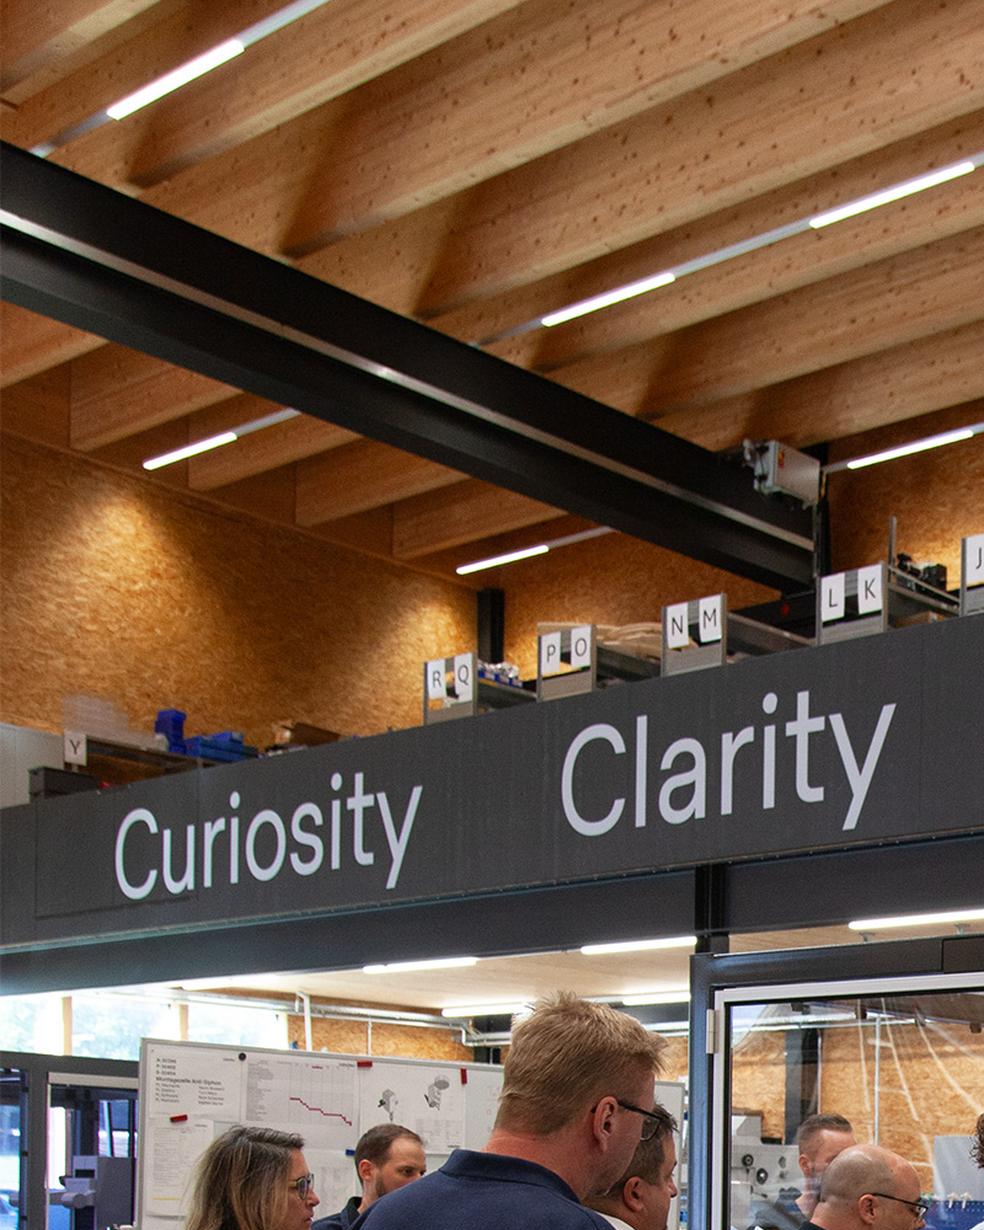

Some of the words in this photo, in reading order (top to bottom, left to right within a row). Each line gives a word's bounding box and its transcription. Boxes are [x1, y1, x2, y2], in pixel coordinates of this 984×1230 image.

[975, 547, 984, 570] J
[828, 588, 839, 609] L
[864, 578, 876, 601] K
[671, 615, 684, 636] N
[702, 607, 717, 629] M
[546, 644, 557, 663] P
[574, 637, 588, 657] O
[432, 670, 443, 688] R
[457, 664, 469, 686] Q
[69, 739, 81, 755] Y
[115, 772, 423, 900] Curiosity
[561, 690, 897, 837] Clarity
